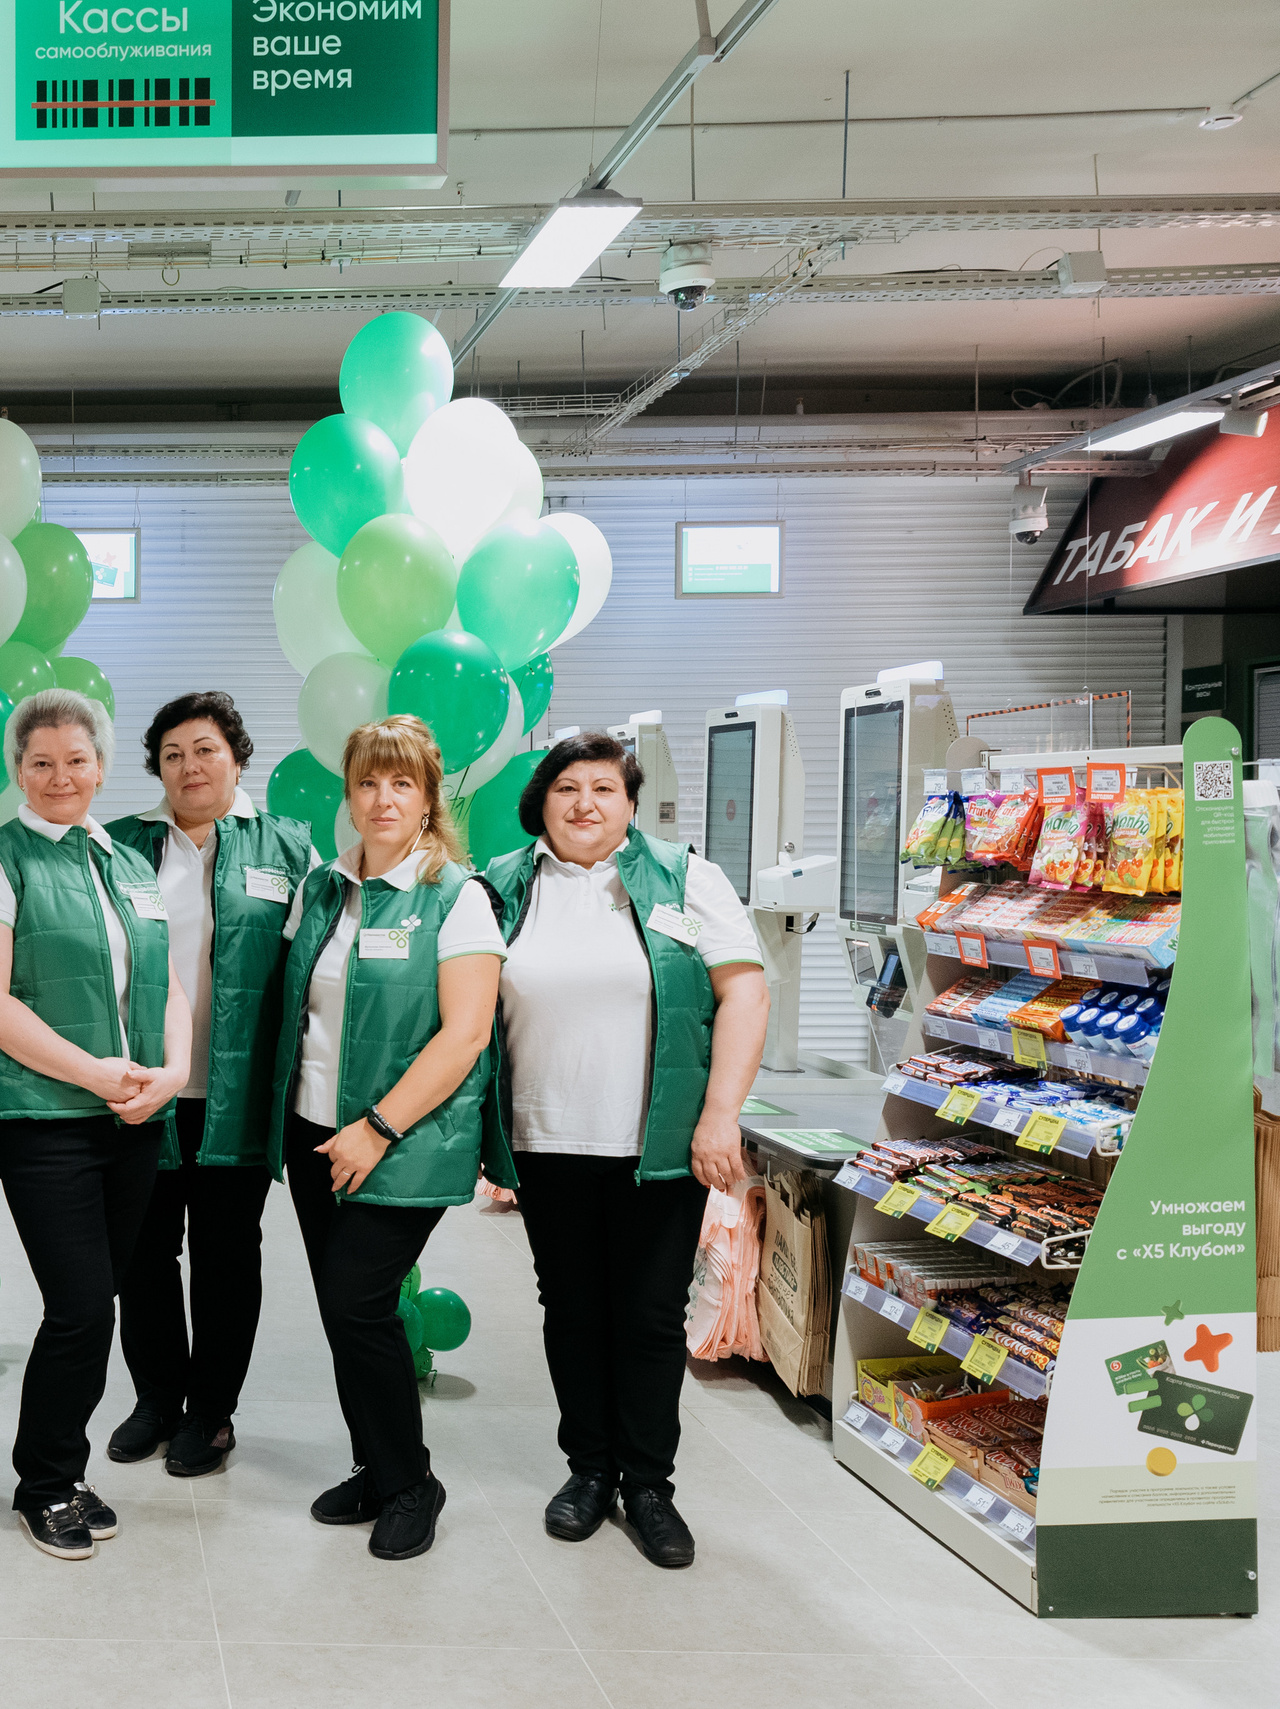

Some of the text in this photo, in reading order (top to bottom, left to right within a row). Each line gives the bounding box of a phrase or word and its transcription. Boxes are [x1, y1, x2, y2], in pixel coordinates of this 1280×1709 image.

[59, 0, 188, 34] Кассы
[252, 0, 422, 23] Экономим
[252, 33, 342, 57] ваше
[252, 67, 353, 97] время
[1053, 485, 1277, 586] ТАБАК И
[1150, 1199, 1246, 1216] Умножаем
[1182, 1222, 1247, 1238] выгоду
[1116, 1248, 1128, 1260] с
[1169, 1242, 1246, 1261] Клубом»
[1166, 1376, 1183, 1386] Карта
